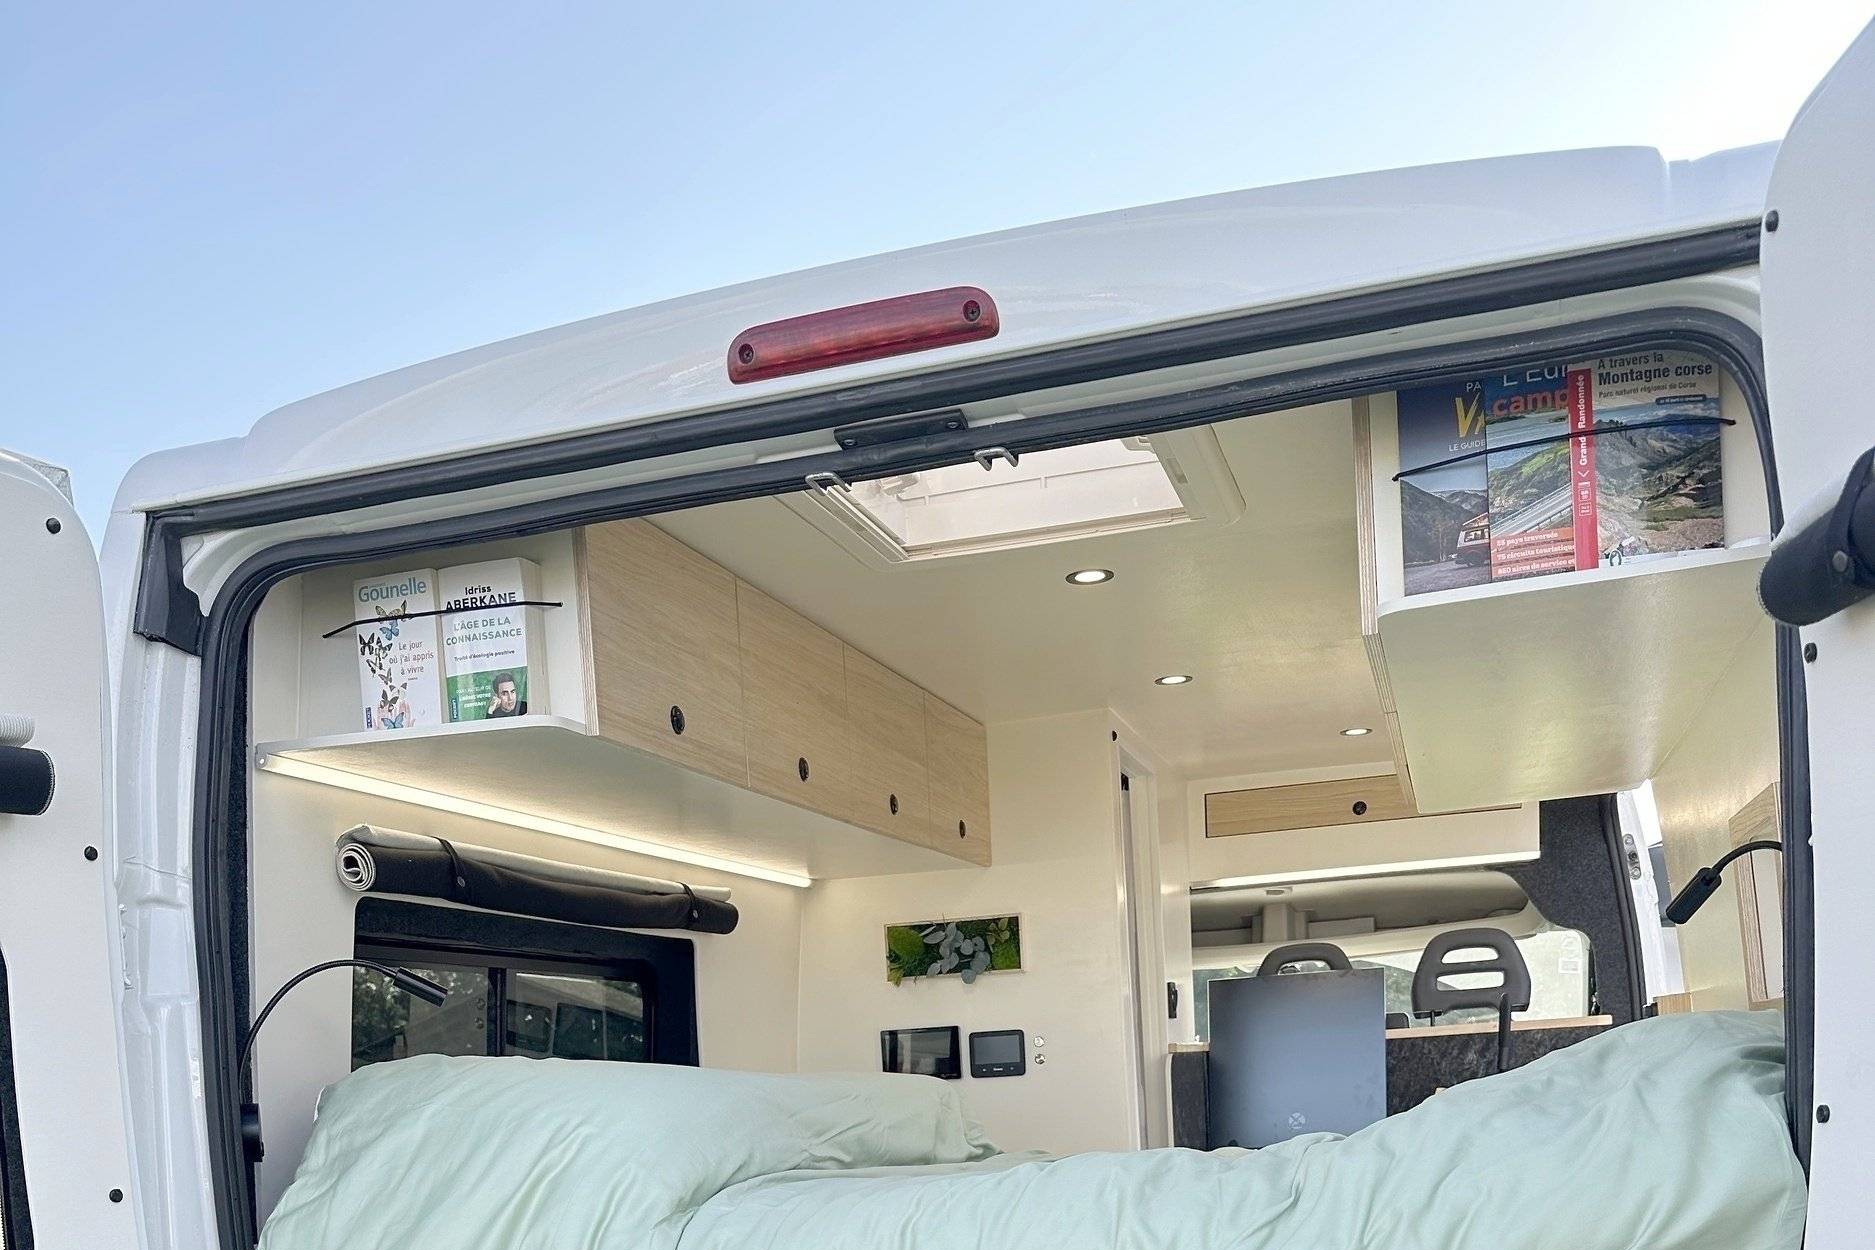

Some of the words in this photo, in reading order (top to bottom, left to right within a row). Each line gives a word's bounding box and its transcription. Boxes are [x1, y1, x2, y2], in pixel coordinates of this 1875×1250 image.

[1609, 354, 1650, 369] travers
[1653, 351, 1664, 363] la
[1598, 367, 1670, 386] Montagne
[1674, 363, 1713, 377] corse
[1449, 443, 1459, 452] LE
[1460, 439, 1486, 450] GUIDE
[1579, 436, 1588, 466] Grand
[358, 576, 427, 603] Gounelle
[465, 584, 492, 596] Idriss
[446, 591, 517, 611] ABERKANE
[481, 618, 496, 628] DE
[497, 616, 511, 626] LA
[445, 627, 523, 646] CONNAISSANCE
[398, 642, 407, 651] Le
[409, 640, 423, 651] jour
[388, 654, 398, 665] où
[412, 650, 434, 663] appris
[407, 665, 424, 675] vivre
